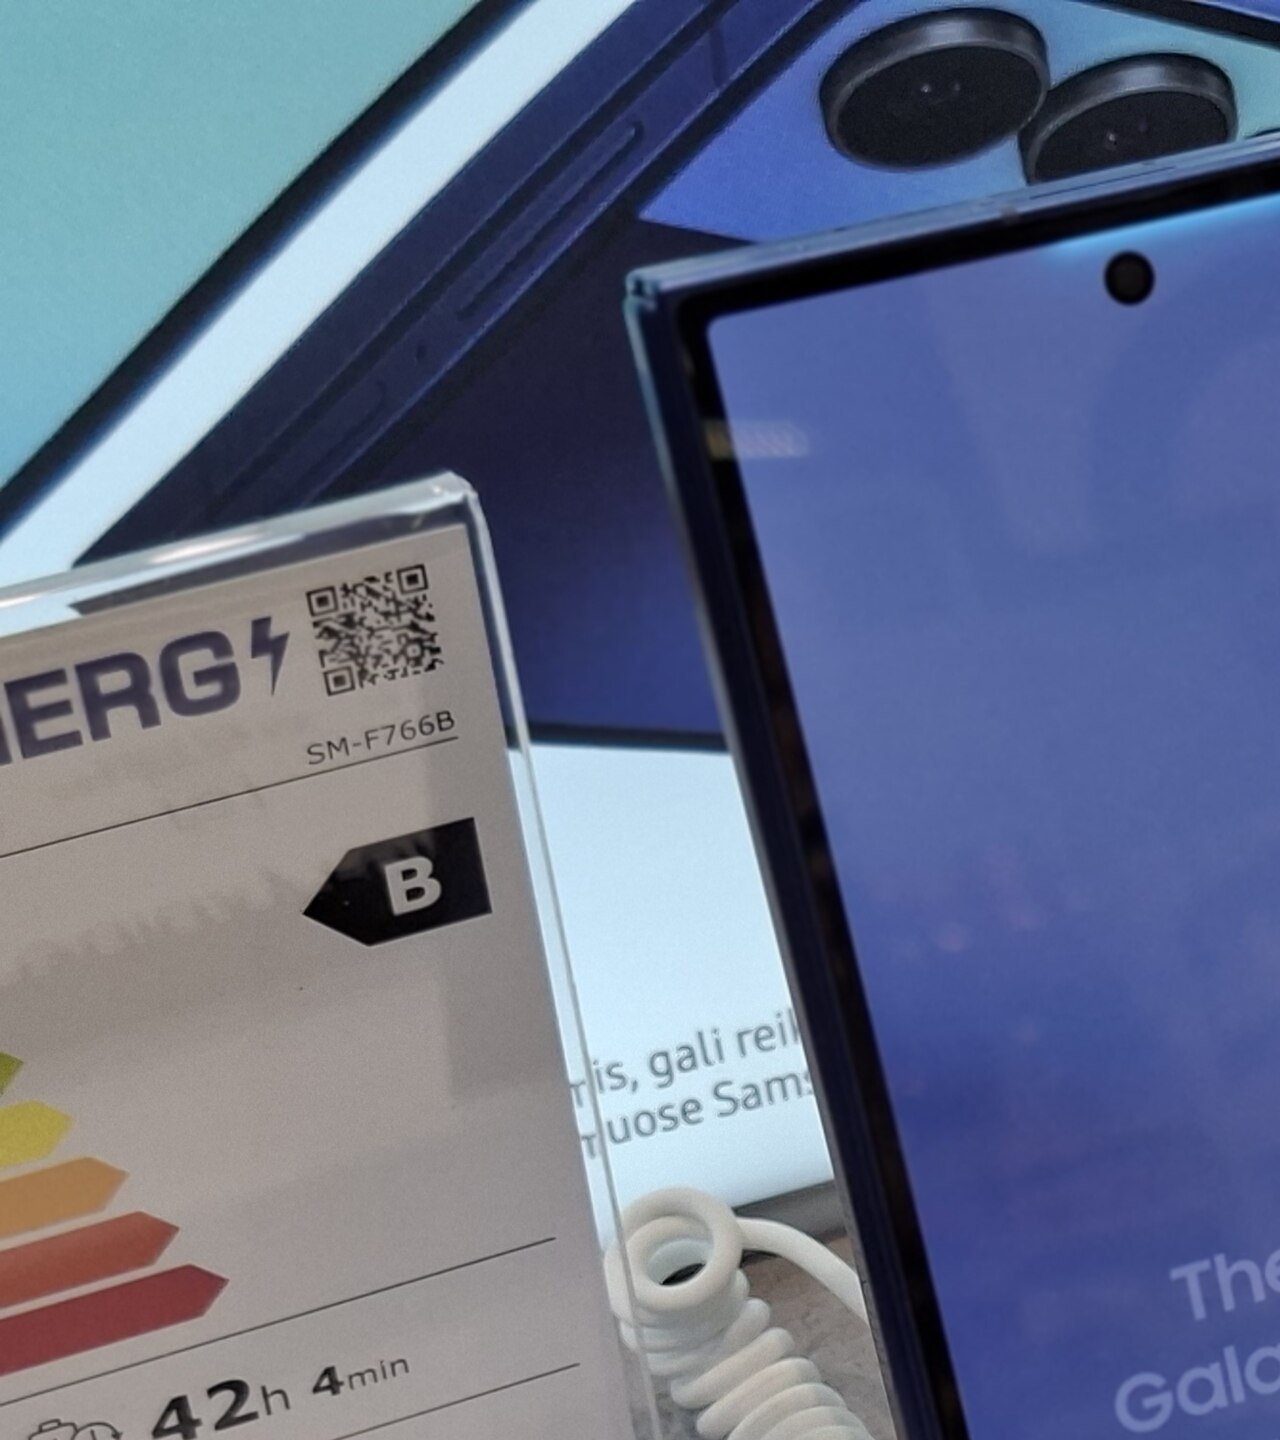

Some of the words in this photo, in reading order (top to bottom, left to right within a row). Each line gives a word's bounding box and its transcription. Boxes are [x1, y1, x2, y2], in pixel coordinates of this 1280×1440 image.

[0, 629, 242, 766] ERG
[306, 709, 457, 766] SM-F766B
[383, 856, 443, 918] B
[649, 1029, 725, 1089] gali
